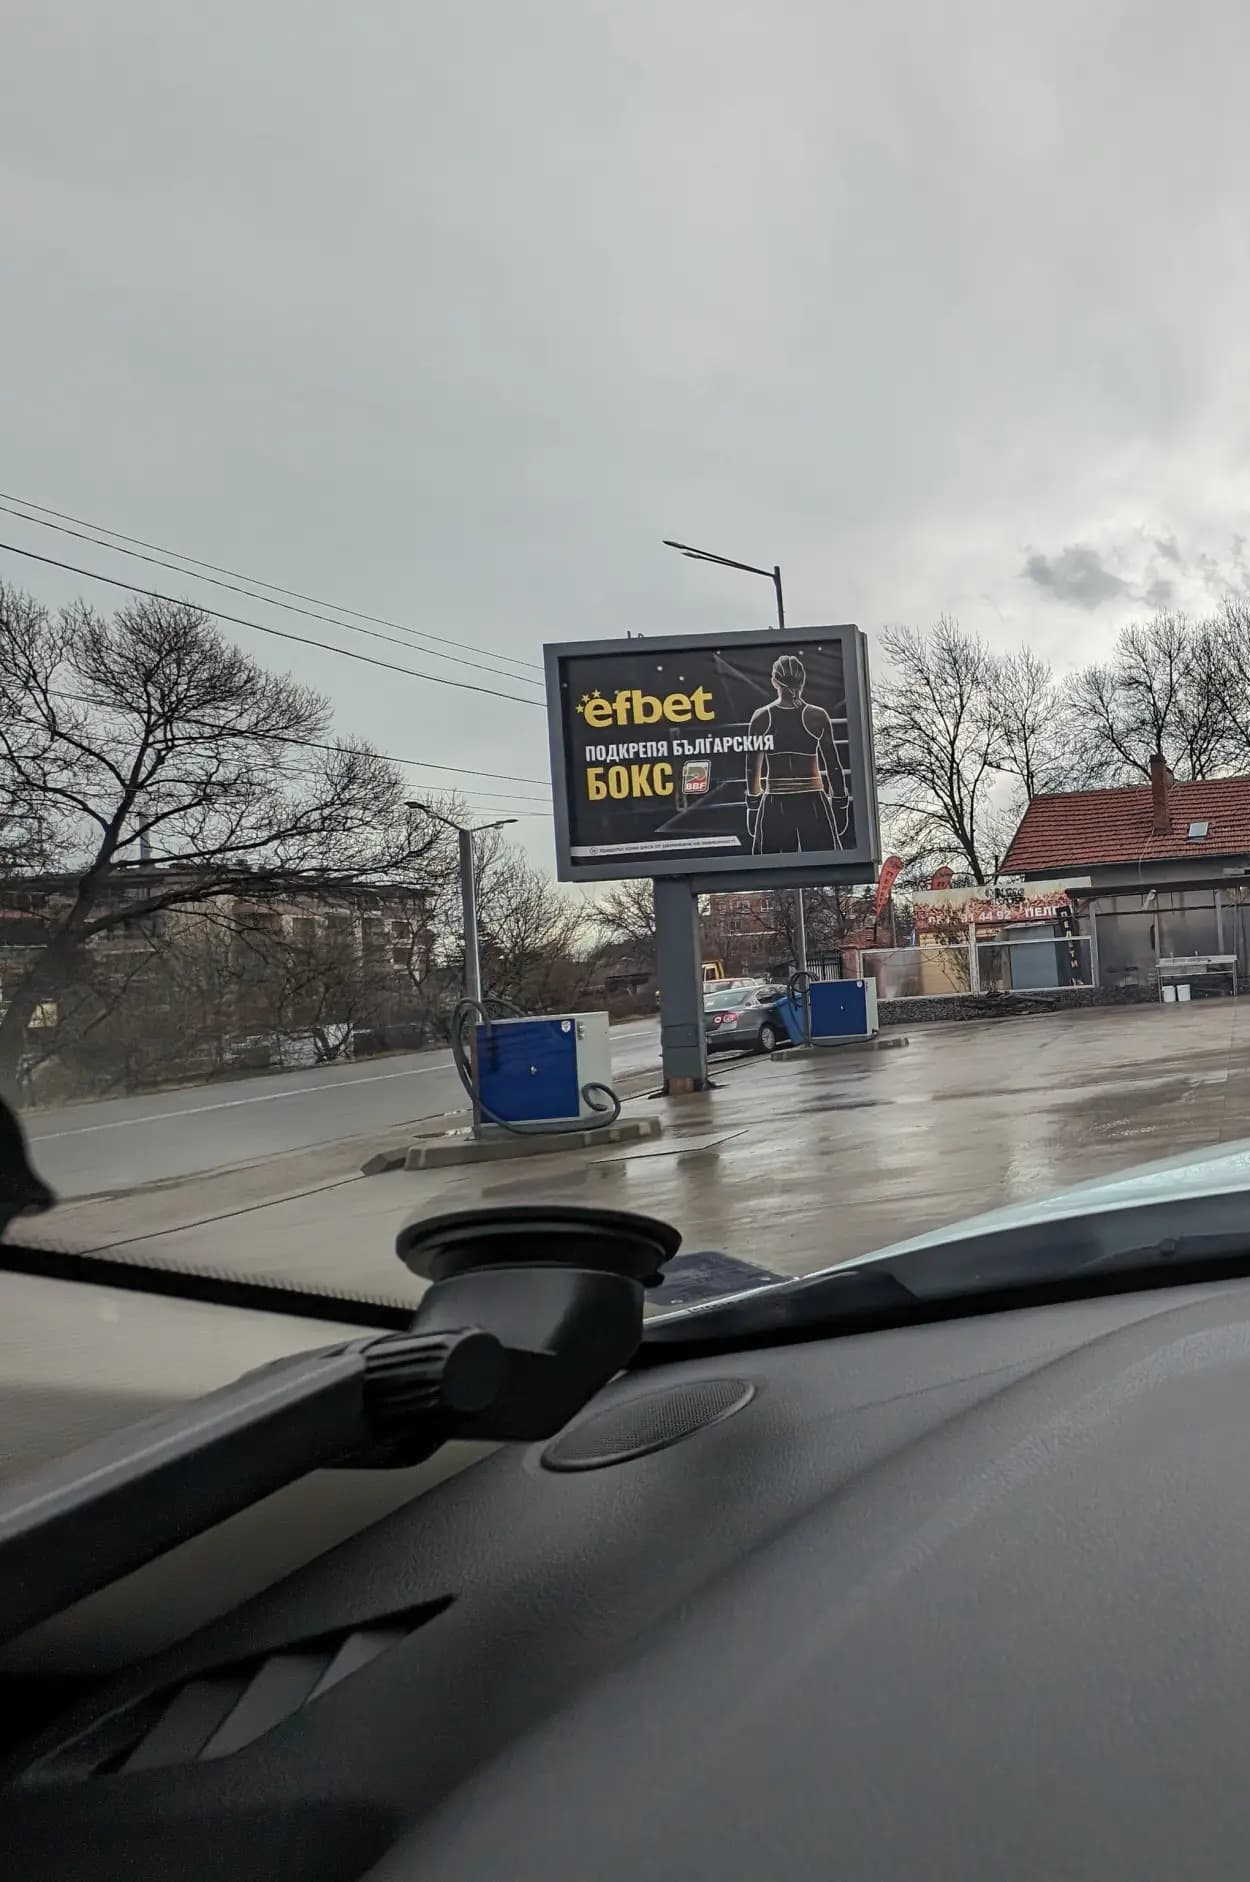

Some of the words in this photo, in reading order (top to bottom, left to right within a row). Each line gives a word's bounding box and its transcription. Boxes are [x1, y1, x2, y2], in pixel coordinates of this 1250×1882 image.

[584, 685, 716, 728] efbet
[585, 740, 669, 763] ПОДКРЕПЯ
[672, 734, 775, 756] БЪЛГАРСКИЯ
[586, 762, 674, 801] БОКС
